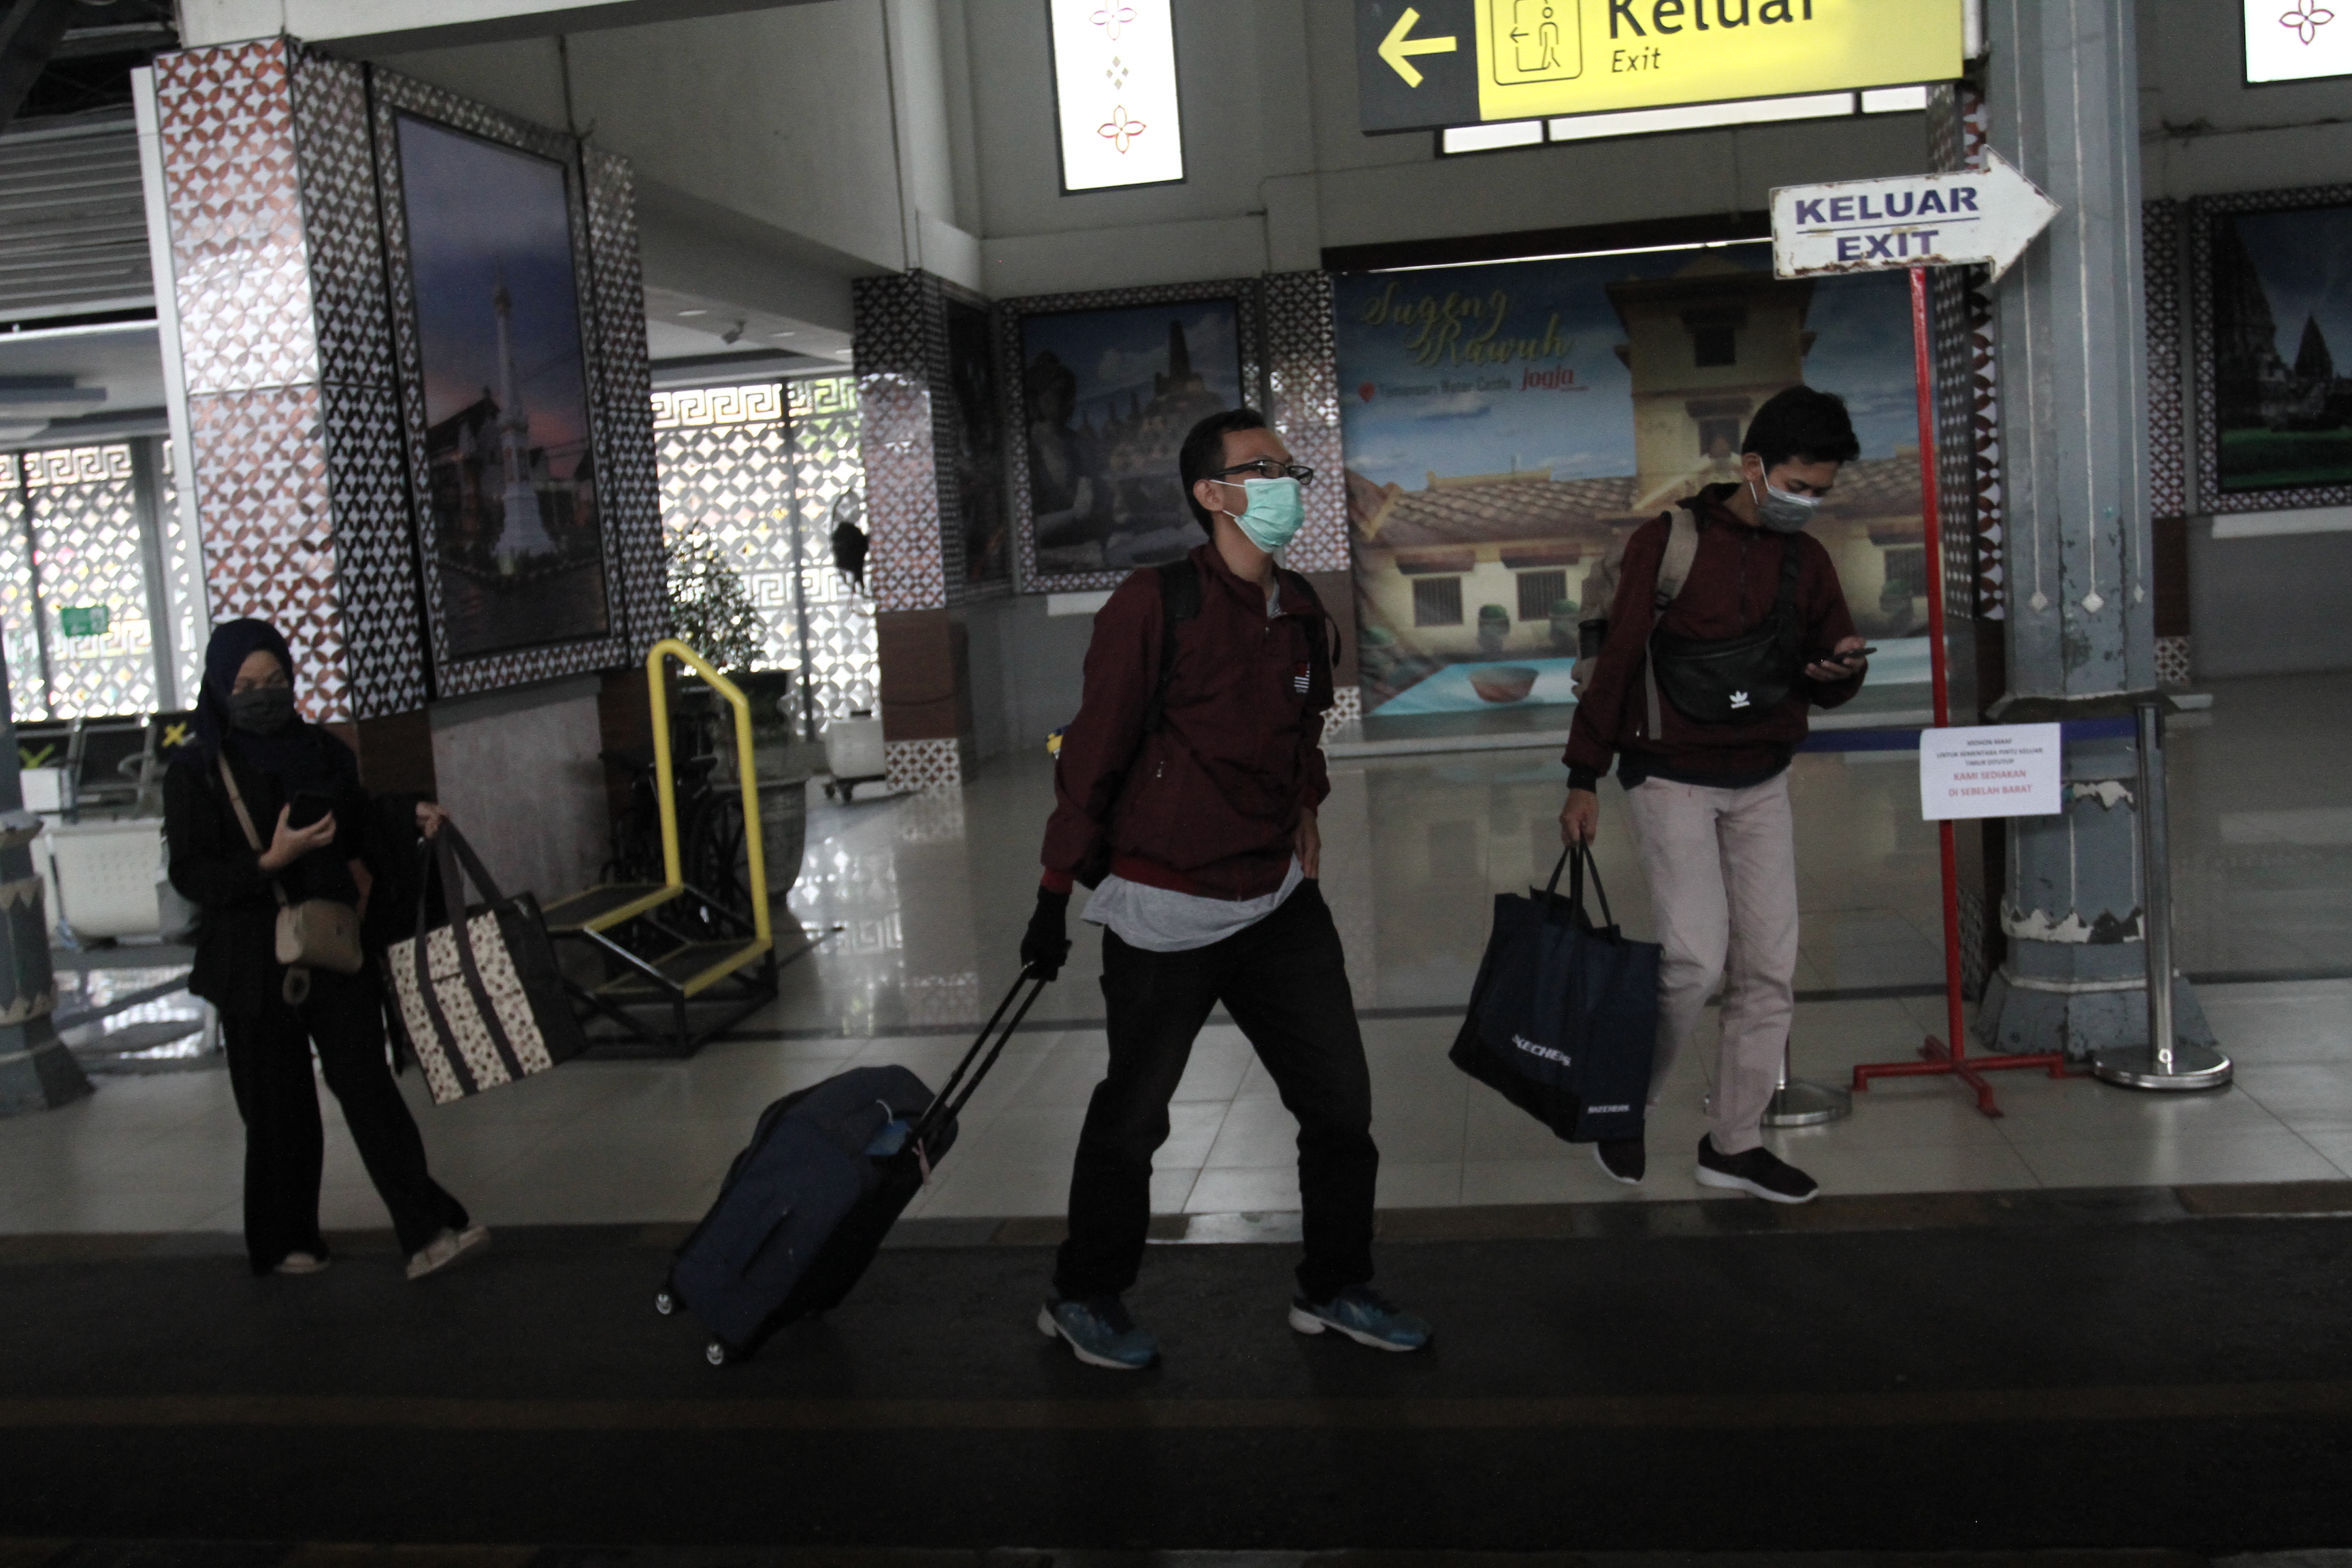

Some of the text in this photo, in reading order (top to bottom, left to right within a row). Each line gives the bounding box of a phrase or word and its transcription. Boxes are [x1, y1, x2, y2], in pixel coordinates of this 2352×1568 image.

[1612, 46, 1661, 73] Exit
[1795, 186, 1979, 225] KELUAR
[1837, 230, 1939, 261] EXIT
[1360, 282, 1509, 349] Sugeng
[1410, 312, 1572, 368] Rawuh
[1953, 772, 1978, 781] KAMI
[2002, 784, 2033, 794] BARAT
